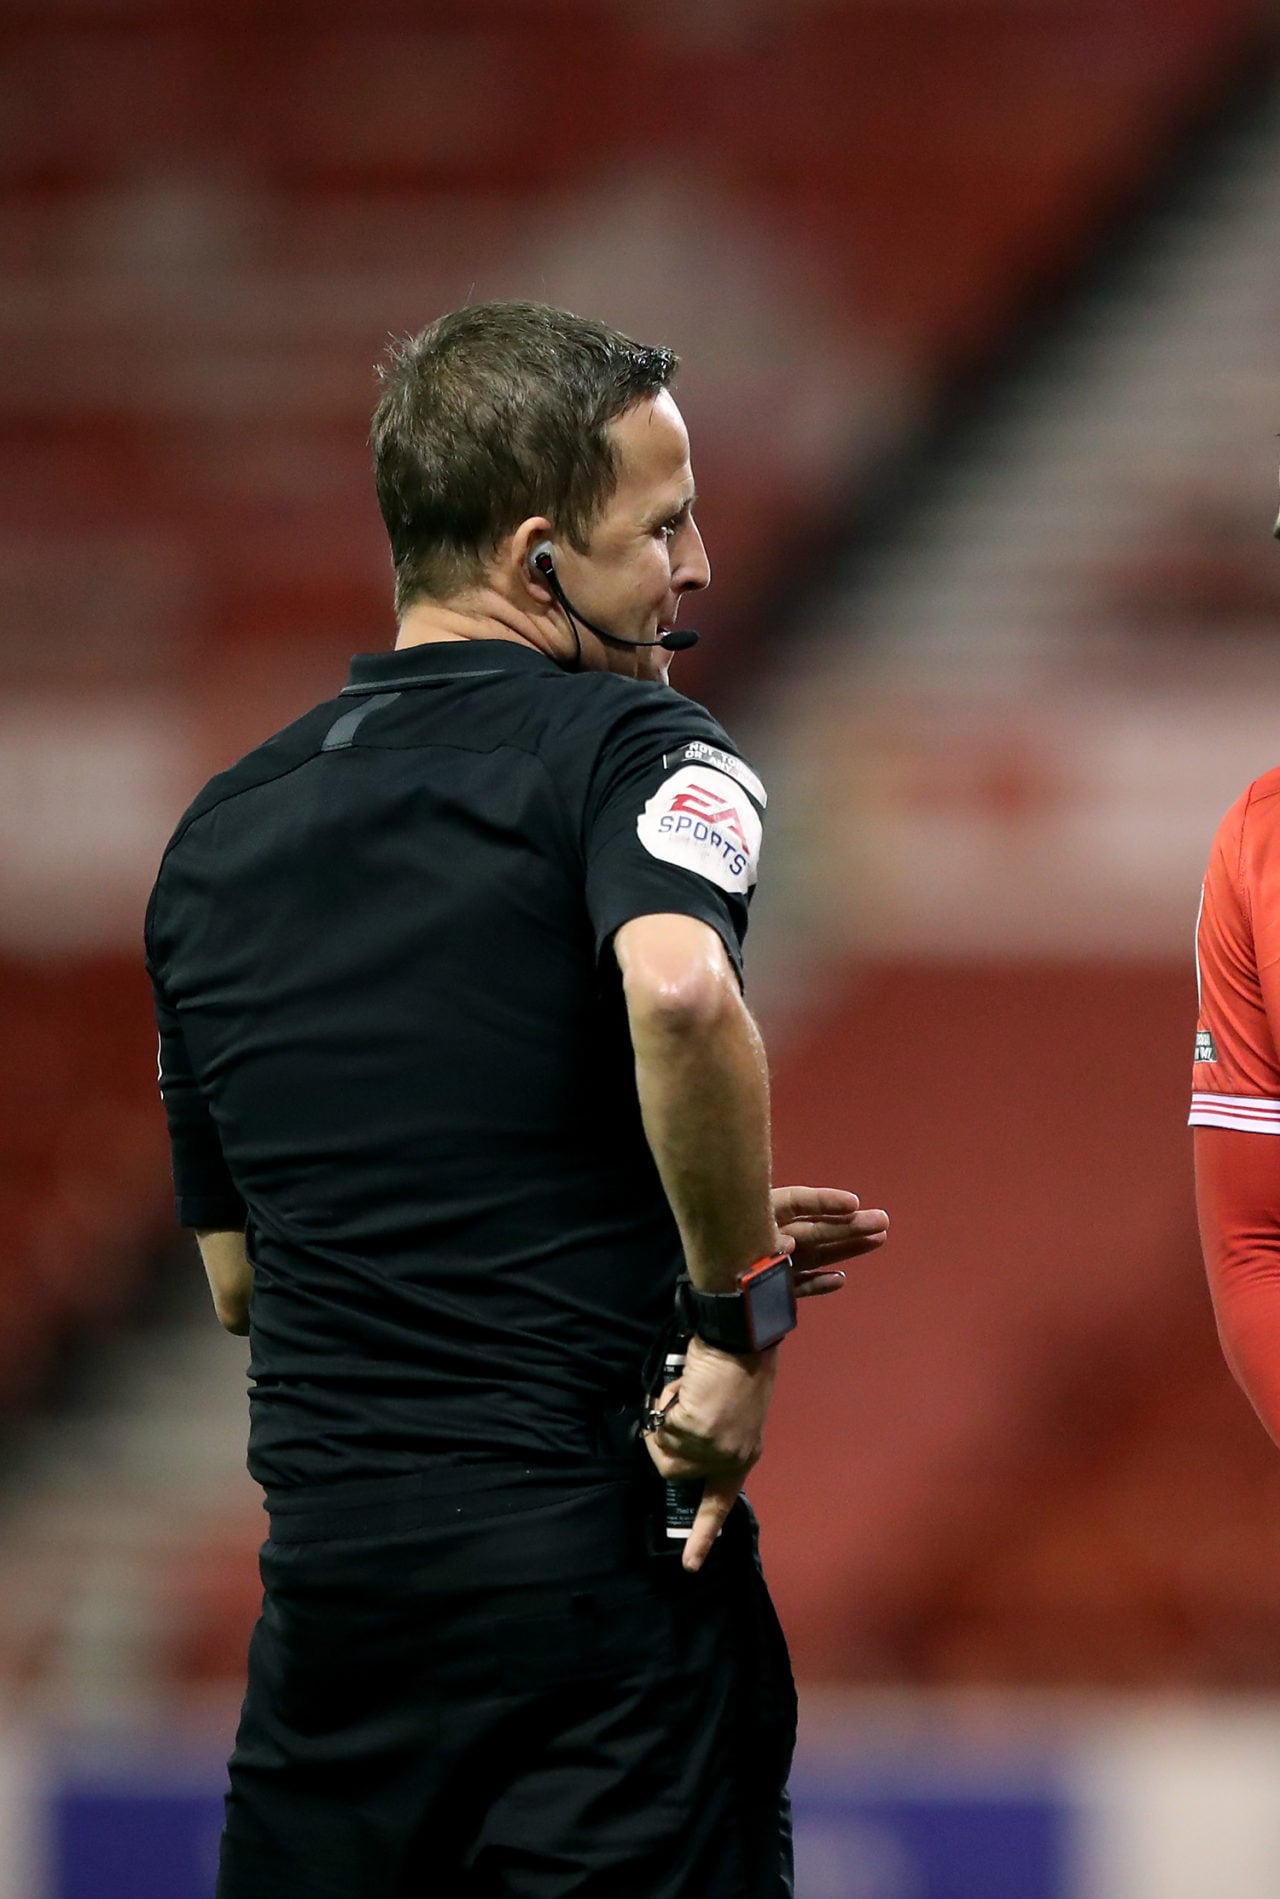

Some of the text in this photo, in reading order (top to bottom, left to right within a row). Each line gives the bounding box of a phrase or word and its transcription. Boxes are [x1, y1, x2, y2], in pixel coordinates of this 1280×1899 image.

[685, 750, 703, 759] OR
[689, 743, 713, 756] NOT
[668, 784, 750, 855] EA
[658, 815, 747, 876] SPORTS
